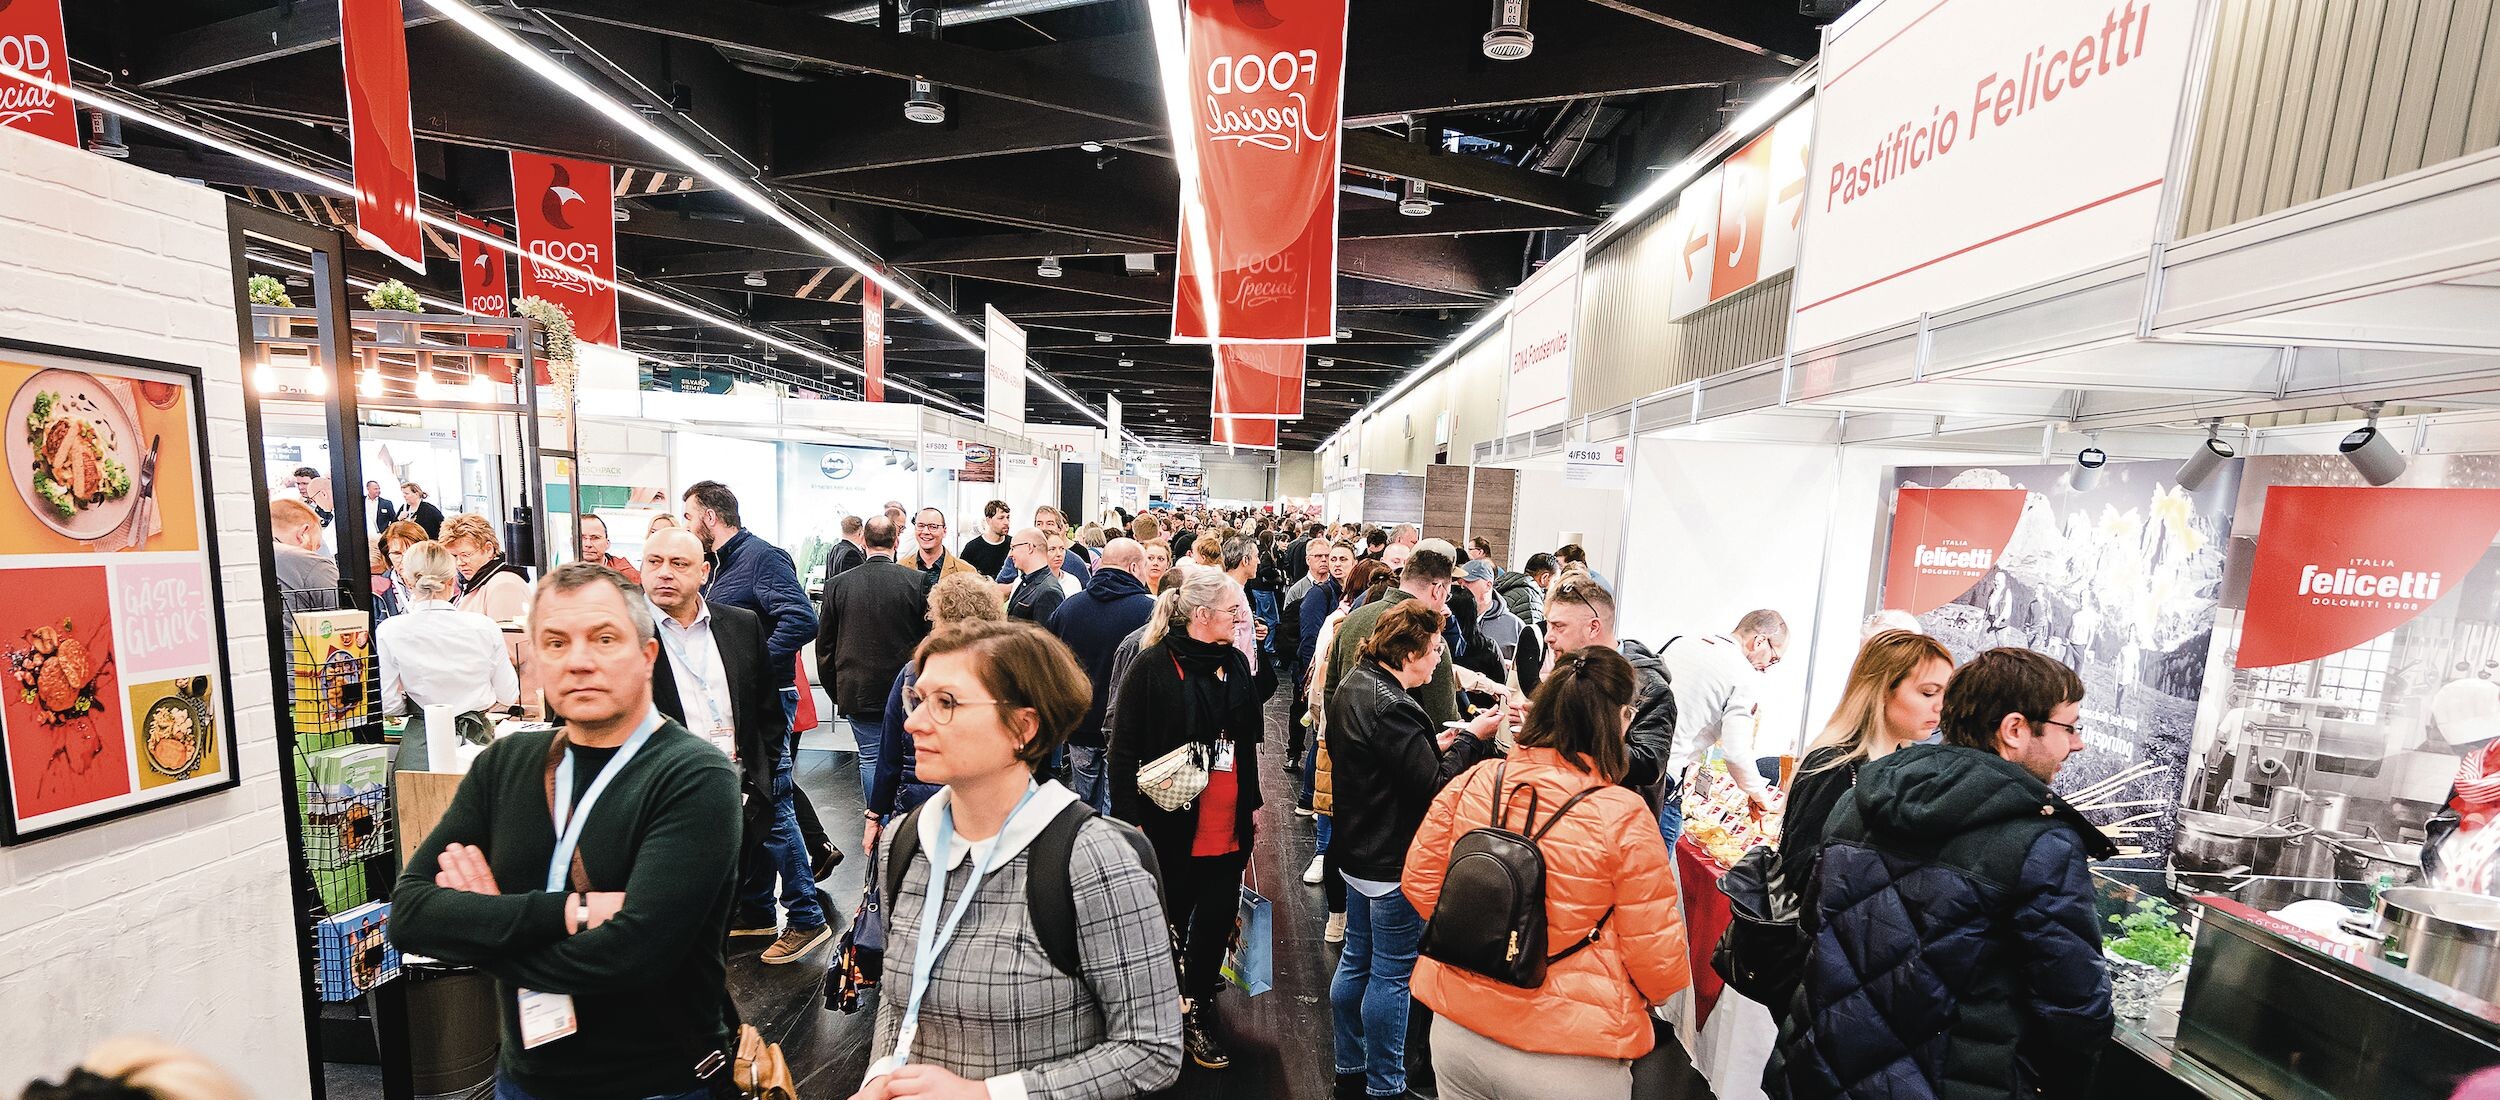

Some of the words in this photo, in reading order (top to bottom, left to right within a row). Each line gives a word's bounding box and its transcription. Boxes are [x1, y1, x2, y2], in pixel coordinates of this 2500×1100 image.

[1826, 104, 1958, 213] Pastificio
[1968, 0, 2151, 141] Felicetti
[1235, 251, 1297, 275] FOOD
[472, 294, 504, 313] FOOD
[1226, 273, 1298, 311] Special
[1514, 348, 1529, 374] EDNA
[1529, 330, 1567, 366] Foodservice
[1568, 450, 1601, 461] 4/FS103
[1914, 544, 1993, 569] felicetti
[2350, 558, 2395, 567] ITALIA
[1922, 568, 1960, 576] DOLOMITI
[2298, 564, 2441, 600] felicetti
[2312, 597, 2379, 609] DOLOMITI
[2387, 601, 2418, 610] 1908
[125, 608, 200, 658] GLÜCK
